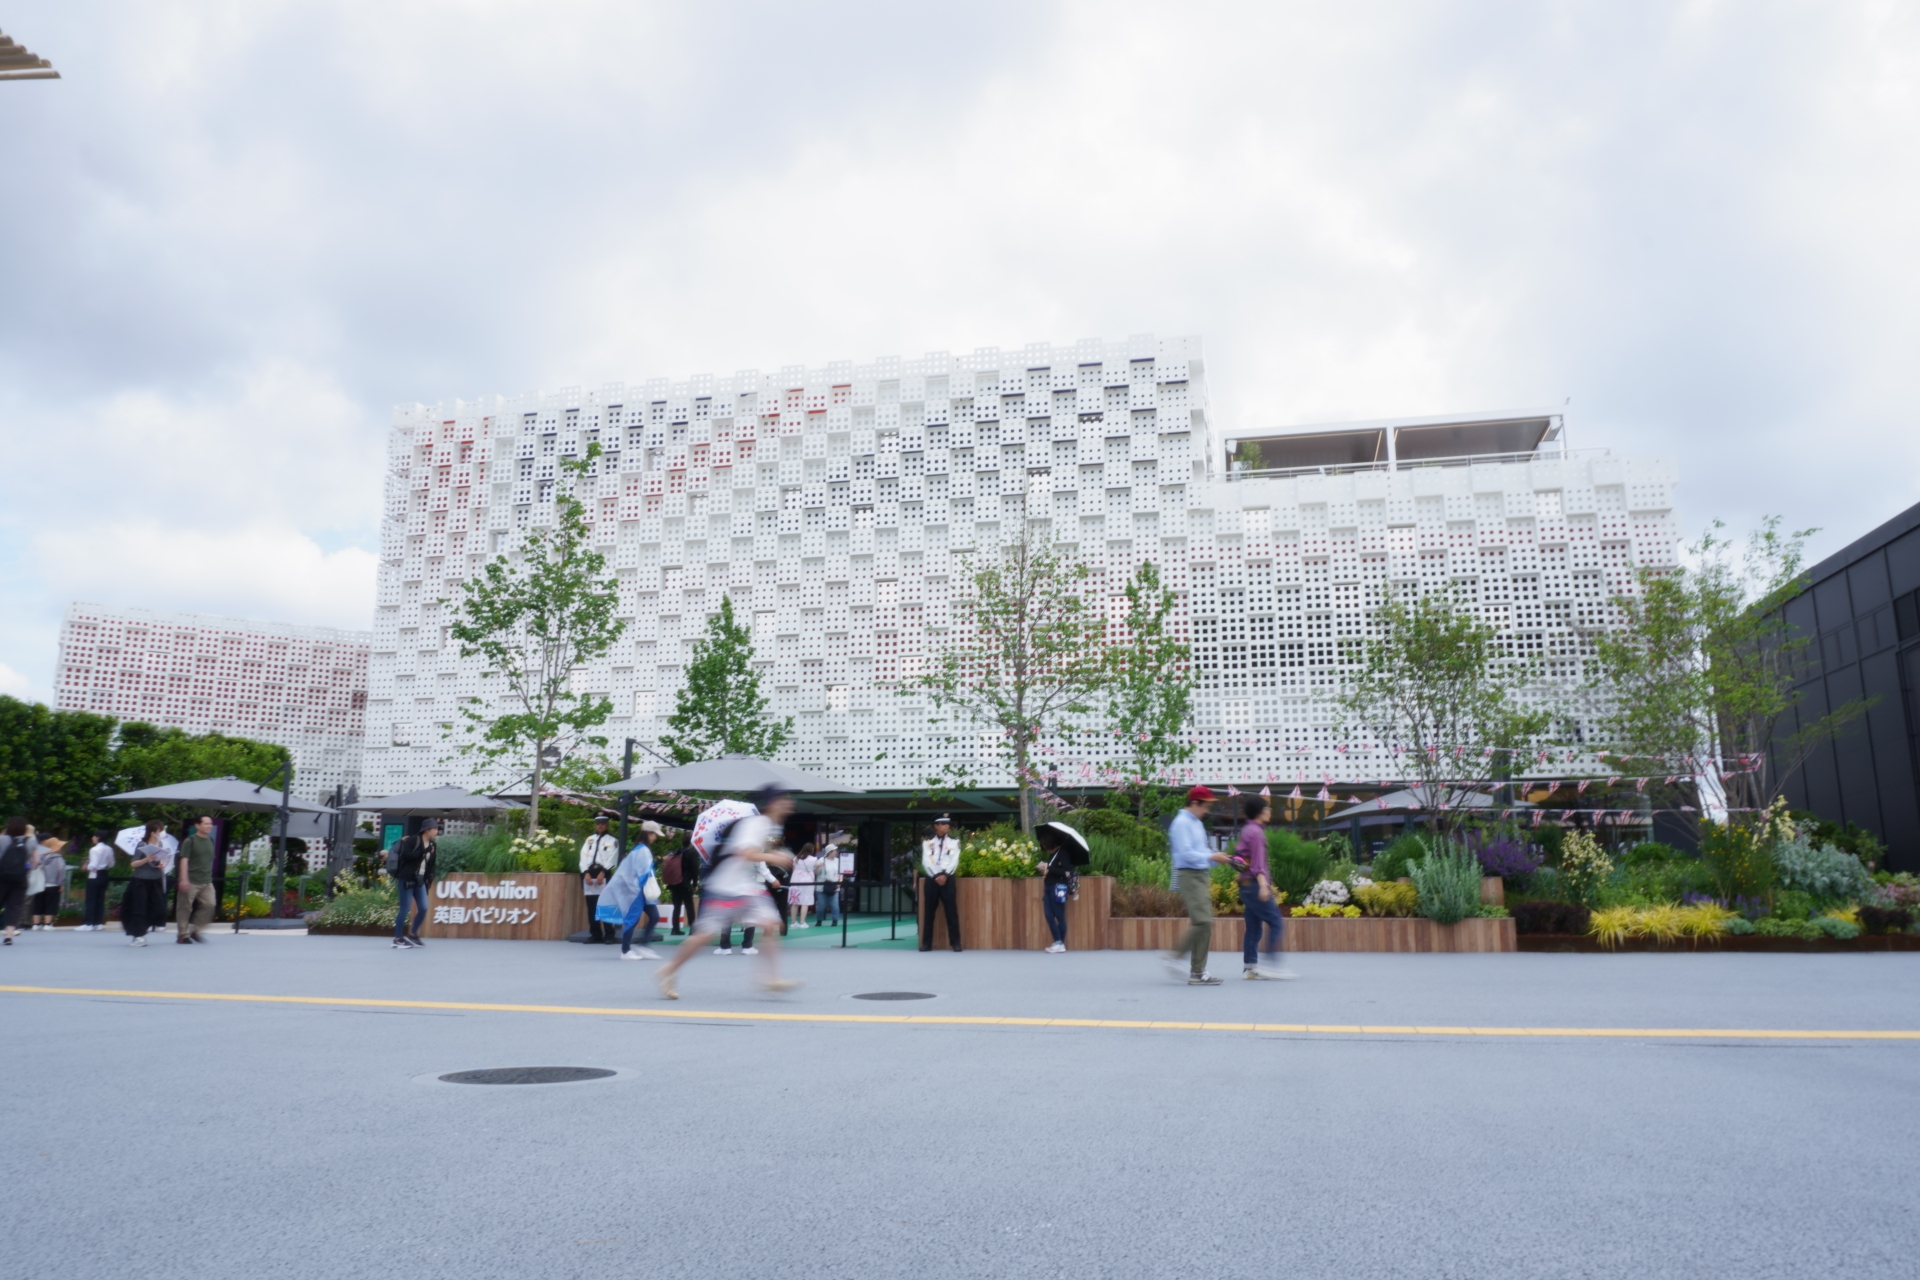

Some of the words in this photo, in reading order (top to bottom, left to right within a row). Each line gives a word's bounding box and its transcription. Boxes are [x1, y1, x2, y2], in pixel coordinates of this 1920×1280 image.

[436, 880, 465, 899] UK
[466, 880, 538, 899] Pavilion
[433, 906, 537, 924] 英国パビリオン
